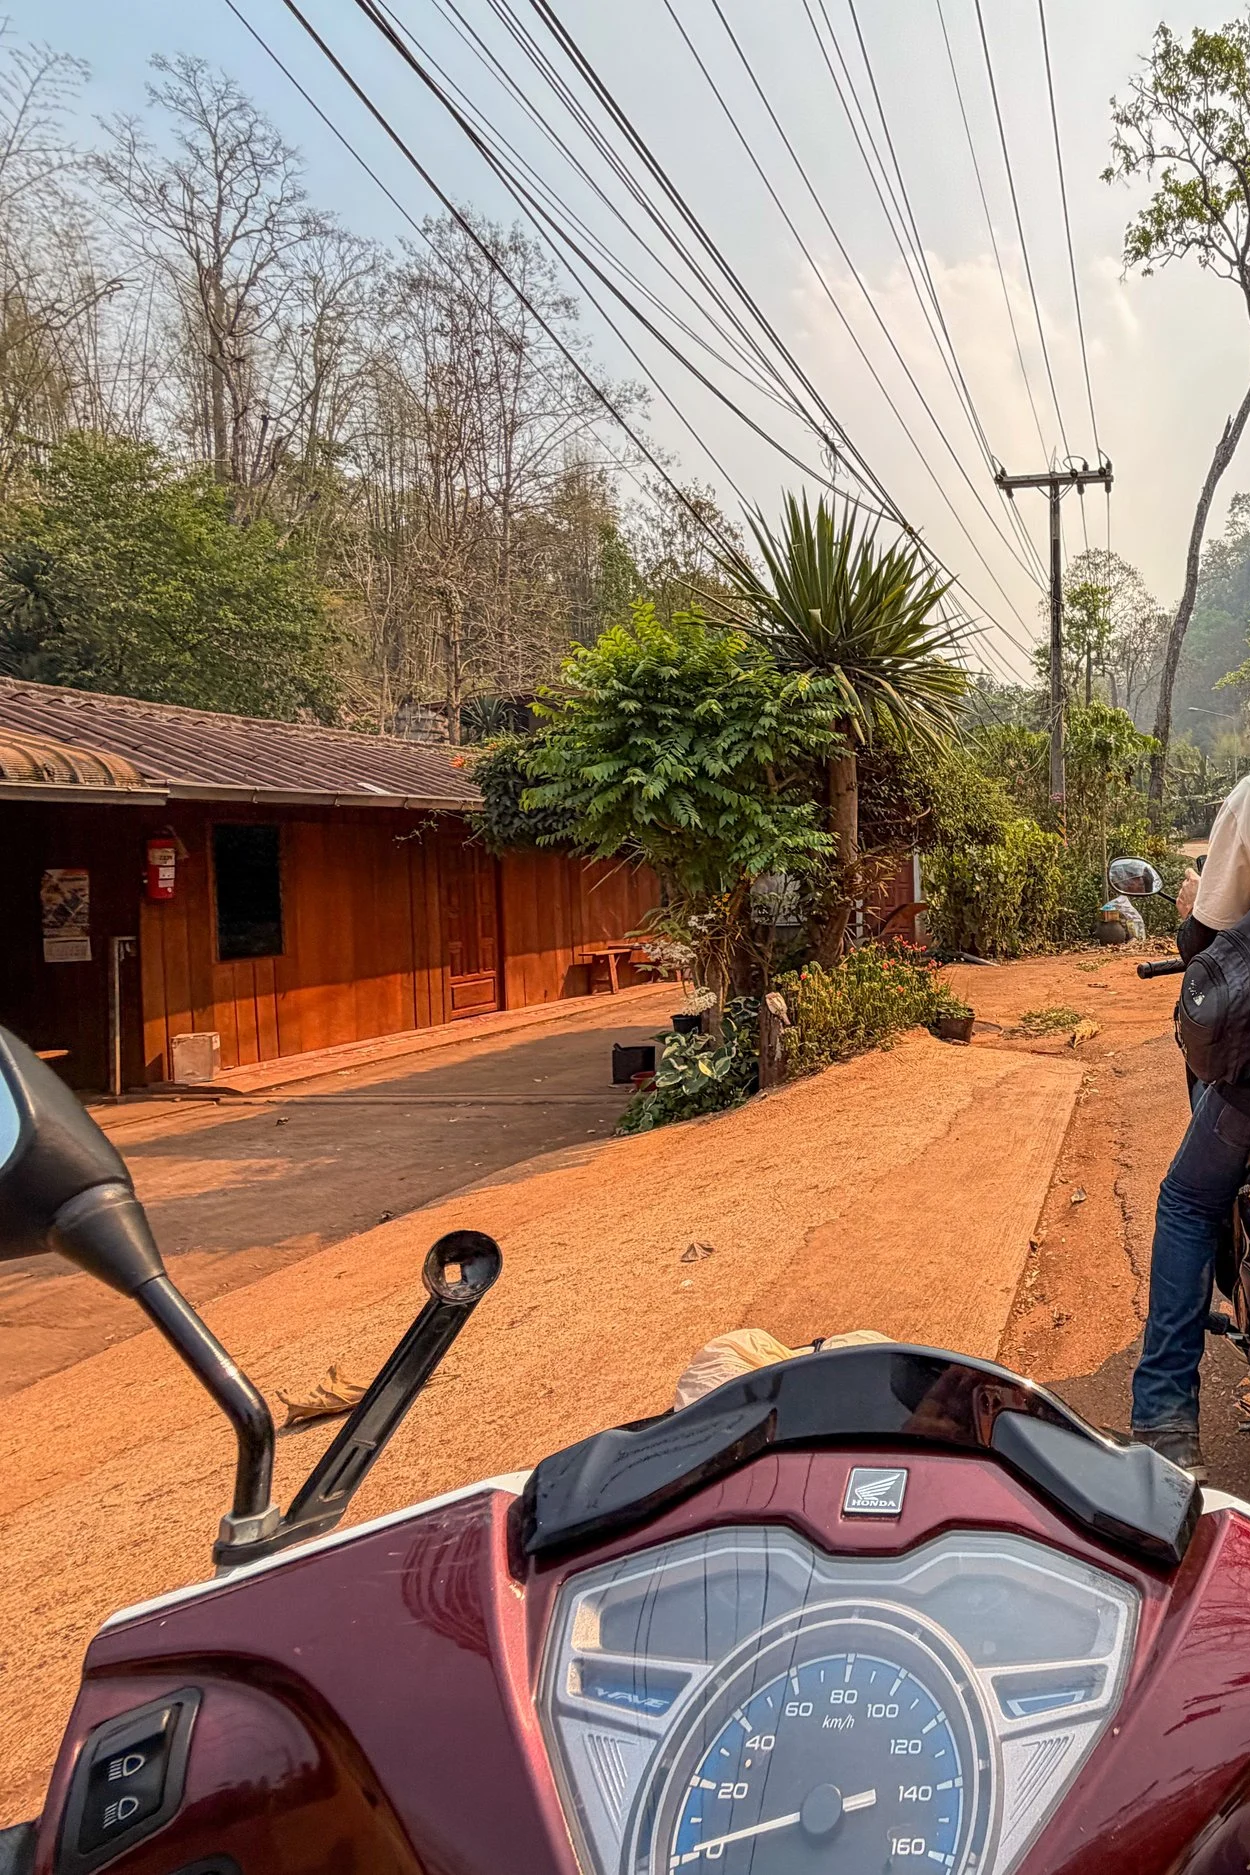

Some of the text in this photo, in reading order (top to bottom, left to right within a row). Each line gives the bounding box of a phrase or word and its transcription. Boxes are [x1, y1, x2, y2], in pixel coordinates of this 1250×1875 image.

[851, 1499, 897, 1508] HONDA
[829, 1689, 858, 1704] 80
[785, 1702, 813, 1717] 60
[866, 1703, 899, 1718] 100
[822, 1713, 855, 1730] km/h
[745, 1735, 776, 1751] 40
[889, 1739, 922, 1755] 120
[717, 1783, 748, 1800] 20
[898, 1785, 933, 1802] 140
[705, 1842, 724, 1860] 0
[891, 1838, 925, 1856] 160
